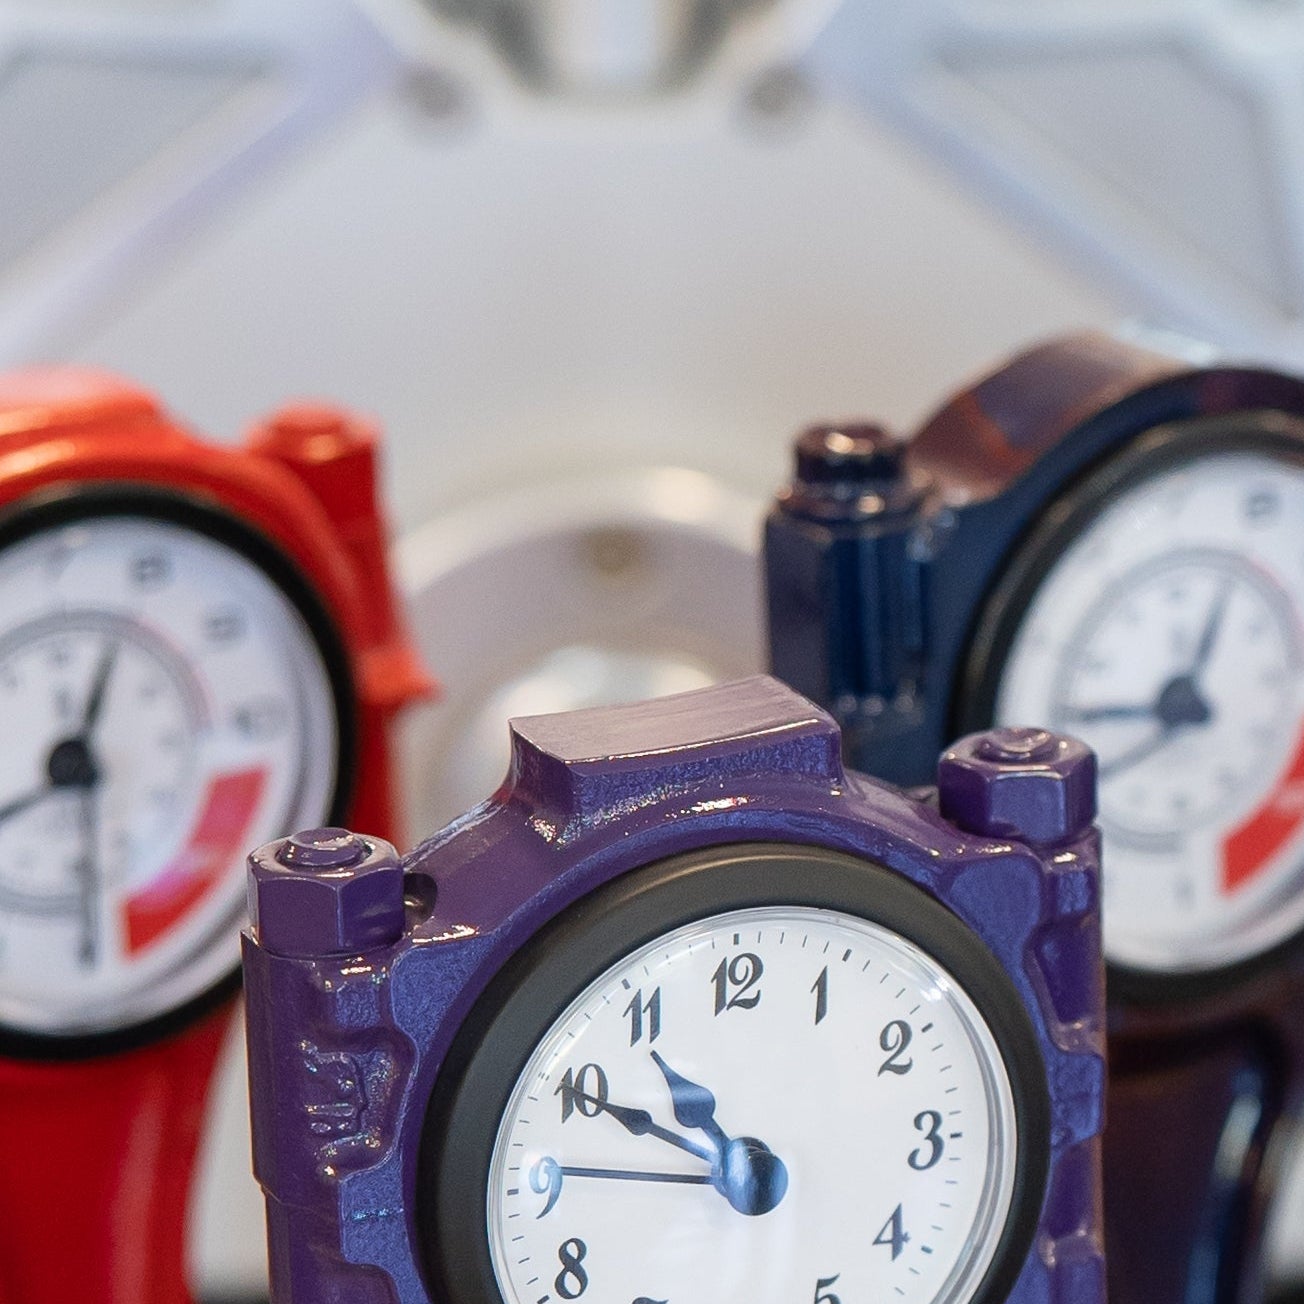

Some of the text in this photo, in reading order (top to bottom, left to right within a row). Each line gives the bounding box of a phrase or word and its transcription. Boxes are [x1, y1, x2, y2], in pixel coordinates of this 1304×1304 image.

[711, 952, 763, 1017] 12
[810, 965, 829, 1025] 1
[622, 986, 662, 1047] 11
[877, 1020, 914, 1077] 2
[558, 1063, 609, 1124] 10
[907, 1110, 945, 1172] 3
[529, 1155, 564, 1219] 9
[872, 1203, 911, 1261] 4
[554, 1238, 588, 1300] 8
